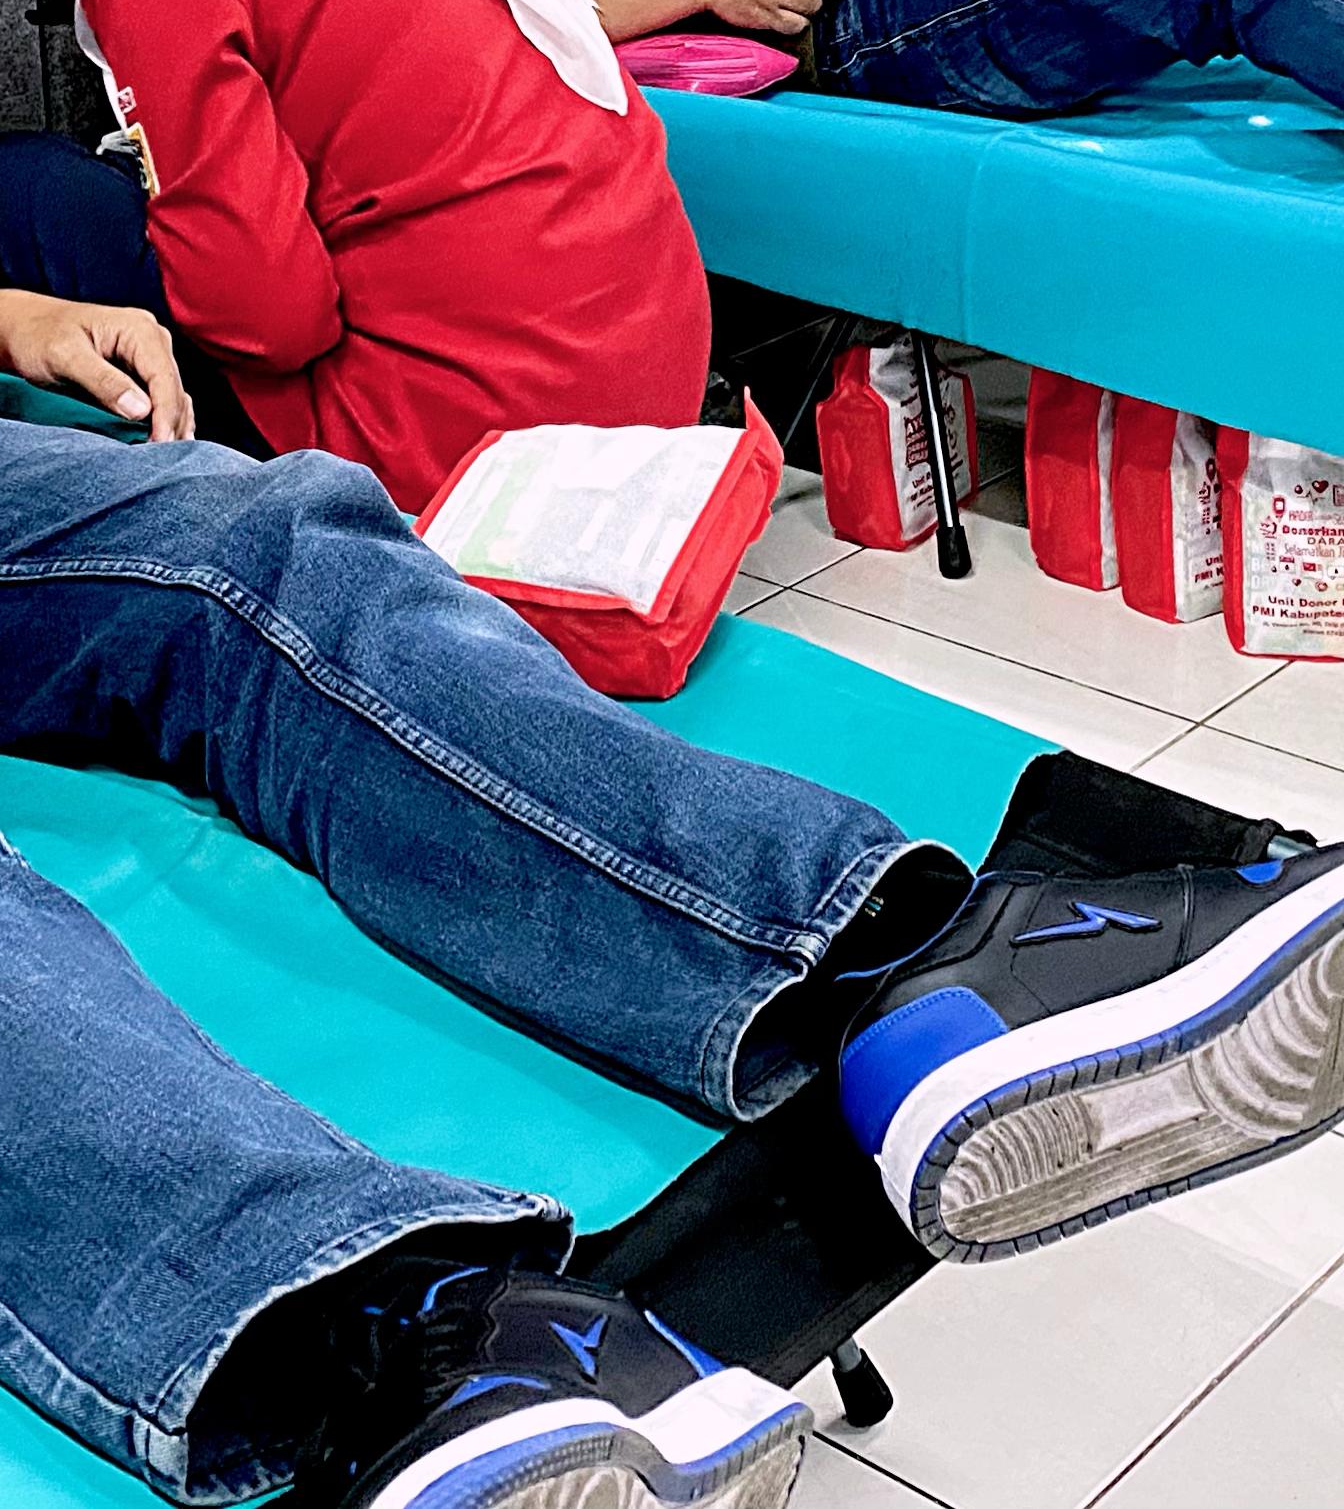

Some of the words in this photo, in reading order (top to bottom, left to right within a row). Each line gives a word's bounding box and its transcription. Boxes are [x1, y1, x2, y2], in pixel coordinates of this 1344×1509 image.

[1268, 595, 1295, 607] Unit
[1299, 598, 1337, 608] Donor
[1252, 605, 1275, 617] PMI
